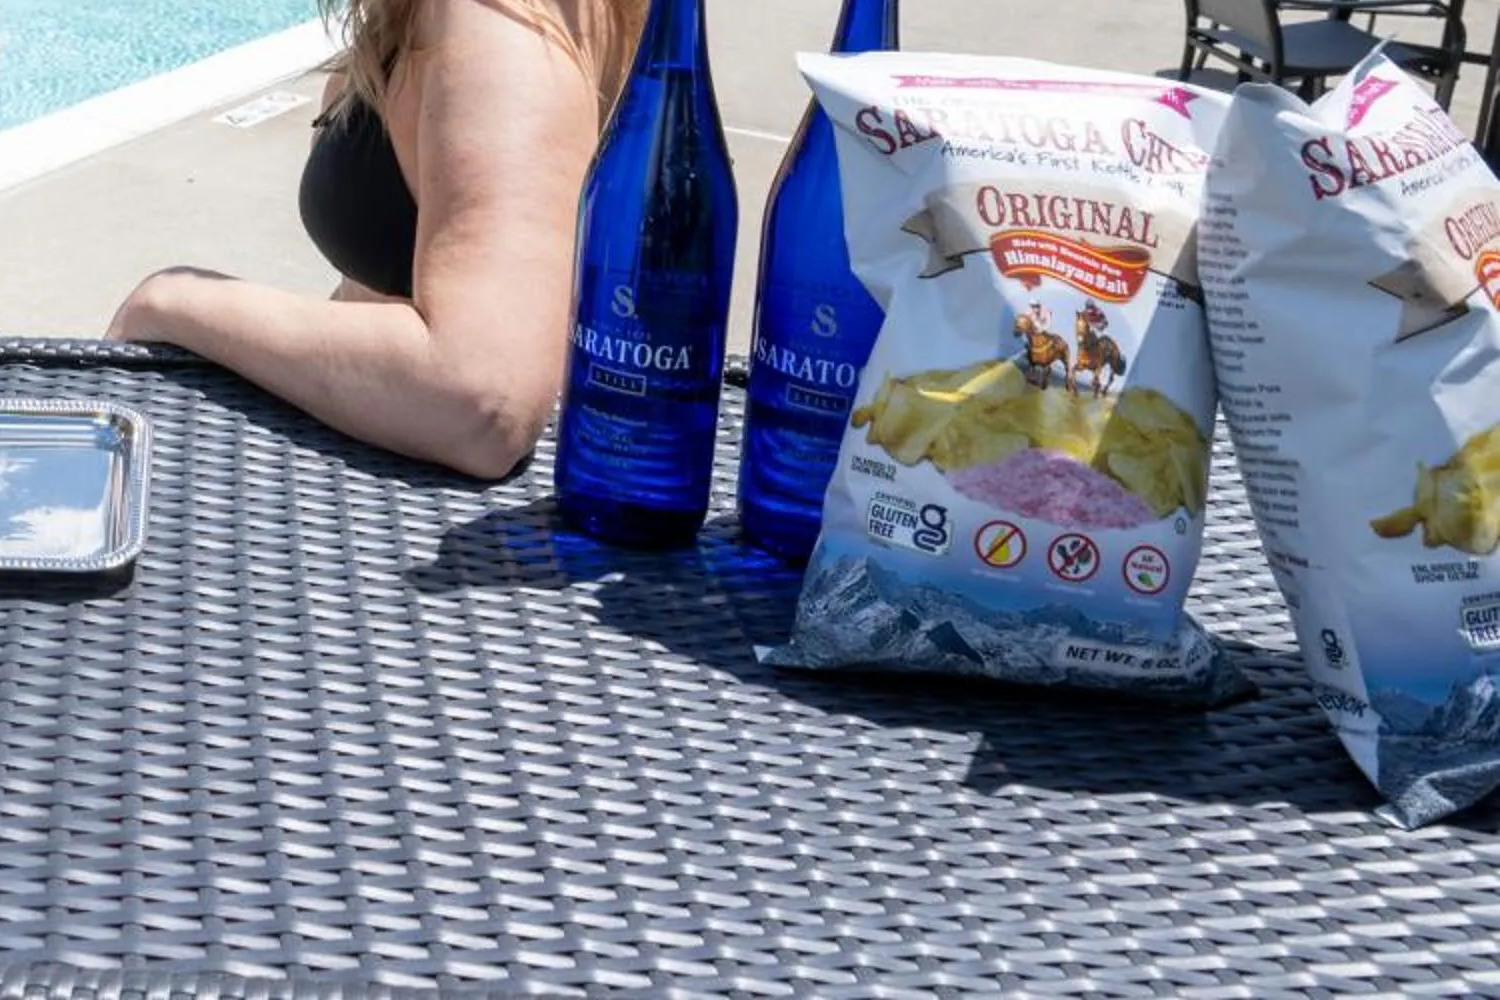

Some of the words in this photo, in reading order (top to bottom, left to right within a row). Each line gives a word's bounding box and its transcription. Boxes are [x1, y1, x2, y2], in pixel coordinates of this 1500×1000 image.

[854, 105, 1115, 155] SARATOGA
[941, 140, 1026, 165] America's
[1037, 151, 1080, 170] First
[976, 185, 1159, 248] ORIGINAL
[1003, 250, 1095, 285] Himalayan
[1095, 273, 1129, 296] Salt
[758, 337, 855, 388] SARATO
[869, 519, 896, 538] FREE
[871, 504, 919, 530] GLUTEN
[1466, 606, 1500, 625] GLUT
[1066, 646, 1100, 661] NET
